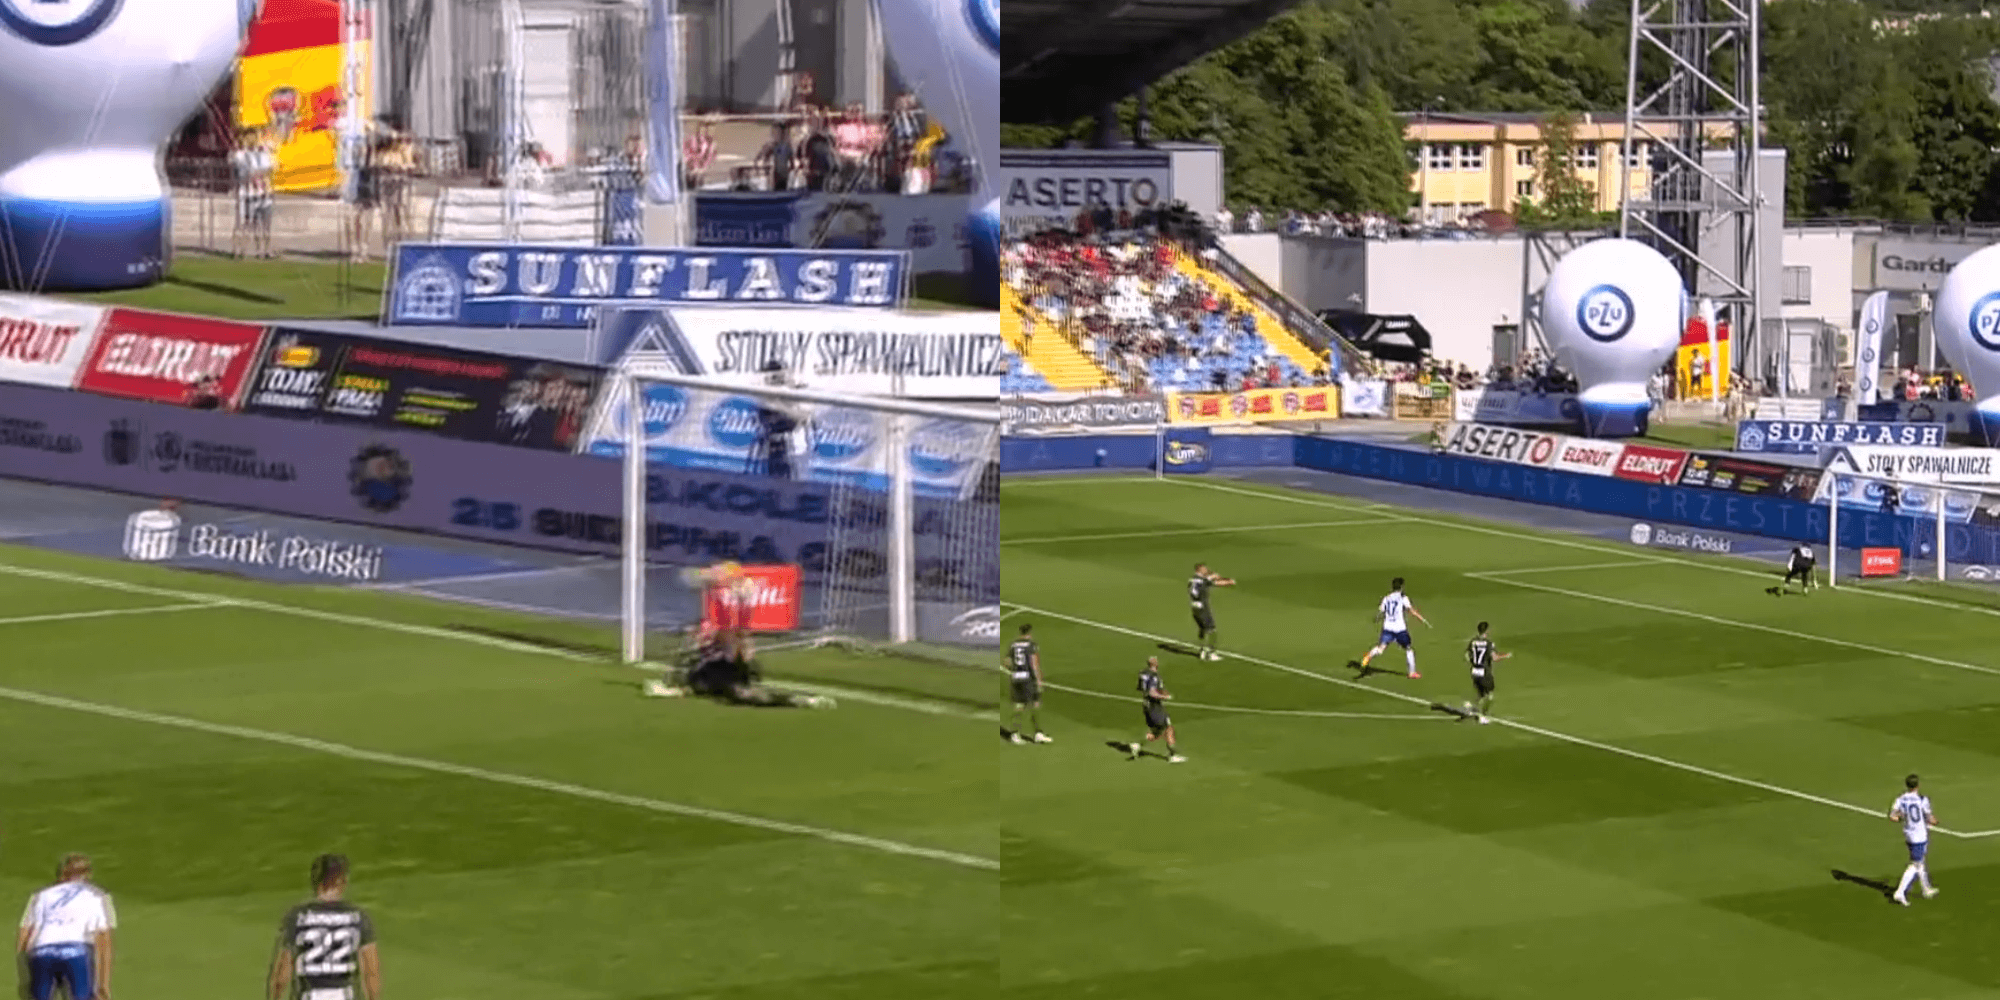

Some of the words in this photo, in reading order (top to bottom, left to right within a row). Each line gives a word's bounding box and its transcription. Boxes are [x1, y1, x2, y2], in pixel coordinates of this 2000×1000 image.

[1005, 177, 1159, 206] ASERTO
[465, 252, 895, 305] SUNFLASH
[1588, 301, 1622, 327] PZU
[1451, 424, 1554, 464] ASERTO
[1768, 422, 1939, 446] SUNFLASH
[1562, 446, 1612, 467] ELDRUT
[1907, 454, 1992, 476] SPAWALNICZE
[188, 523, 275, 566] Bank
[277, 536, 383, 580] Polski
[1656, 529, 1688, 547] Bank
[1692, 534, 1731, 553] Polski
[1472, 647, 1488, 666] 17
[296, 926, 360, 975] 22
